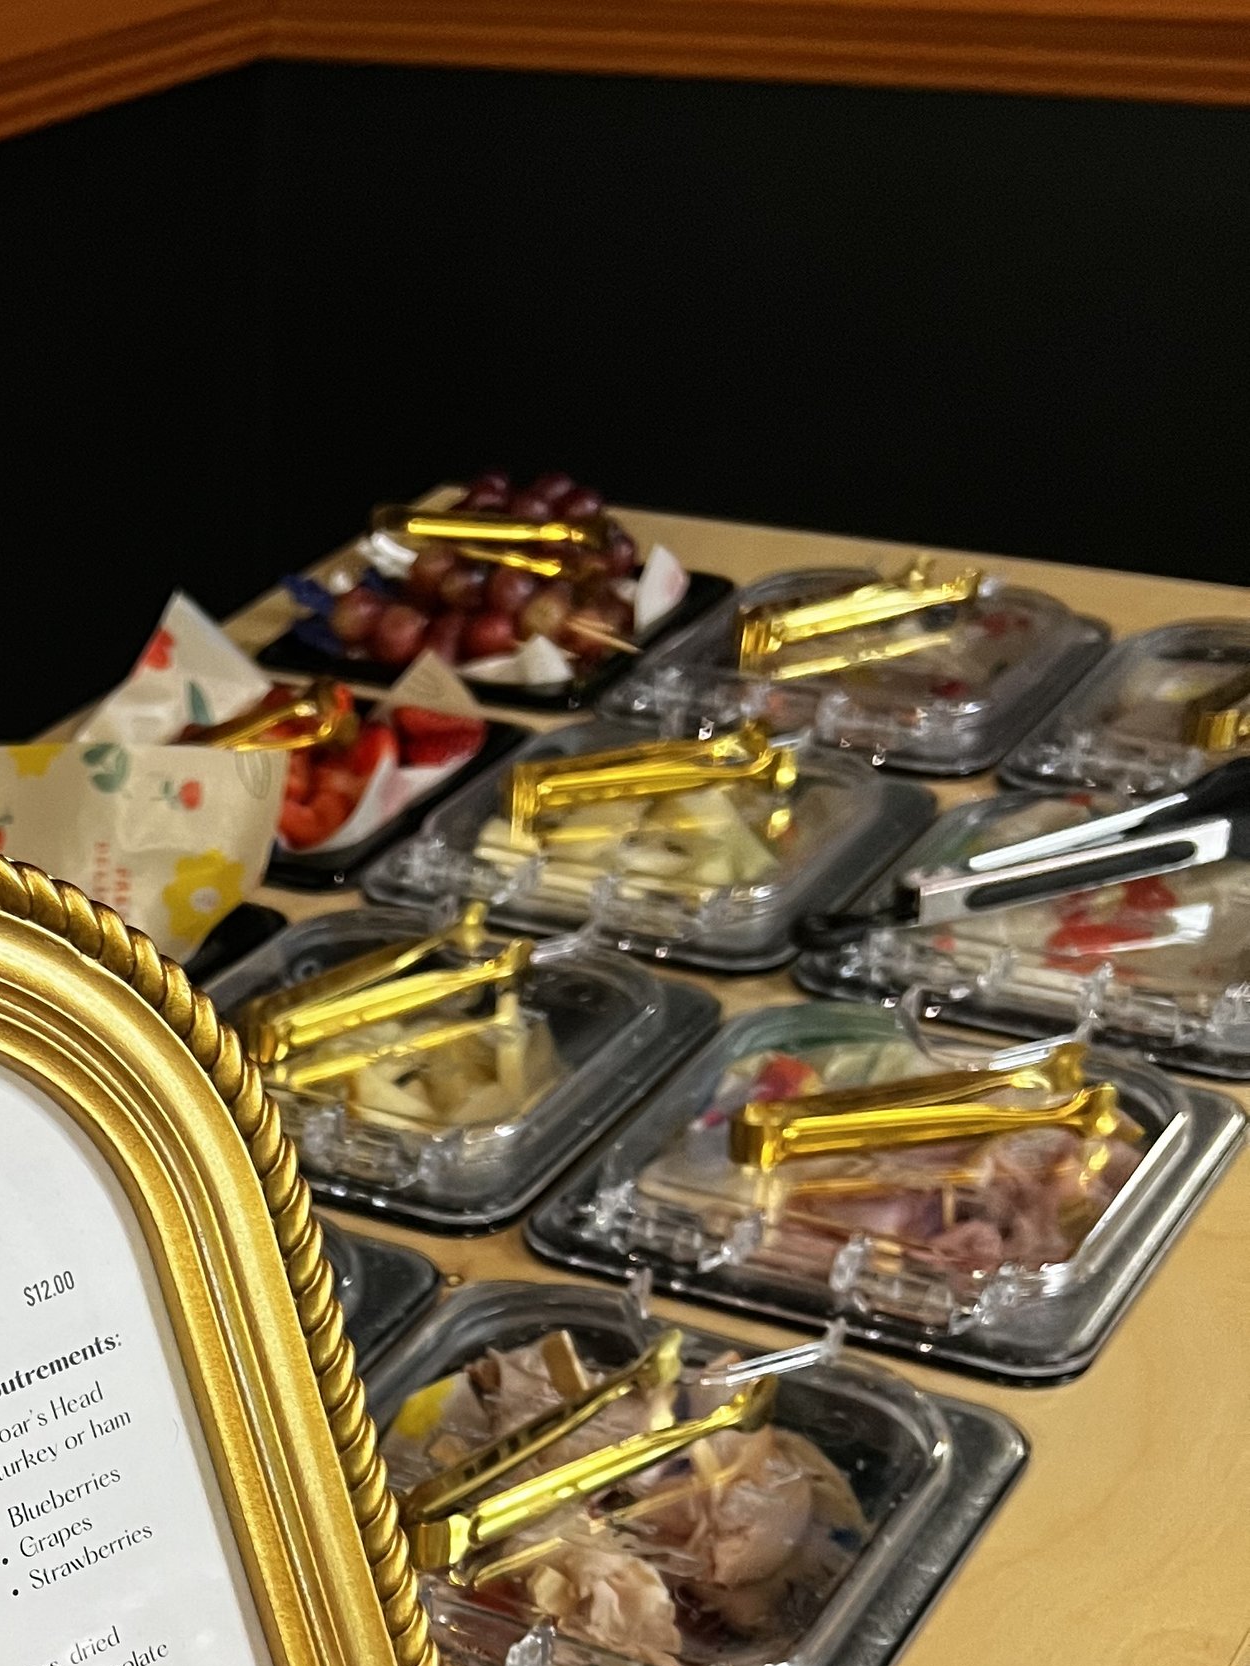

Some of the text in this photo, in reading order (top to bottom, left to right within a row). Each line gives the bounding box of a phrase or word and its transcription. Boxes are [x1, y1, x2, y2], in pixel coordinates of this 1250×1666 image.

[50, 1380, 104, 1421] Head
[64, 1430, 86, 1450] or
[89, 1411, 132, 1439] ham
[7, 1468, 121, 1529] Blueberries
[19, 1517, 93, 1558] Grapes
[28, 1525, 154, 1590] Strawberries
[69, 1625, 121, 1665] dried
